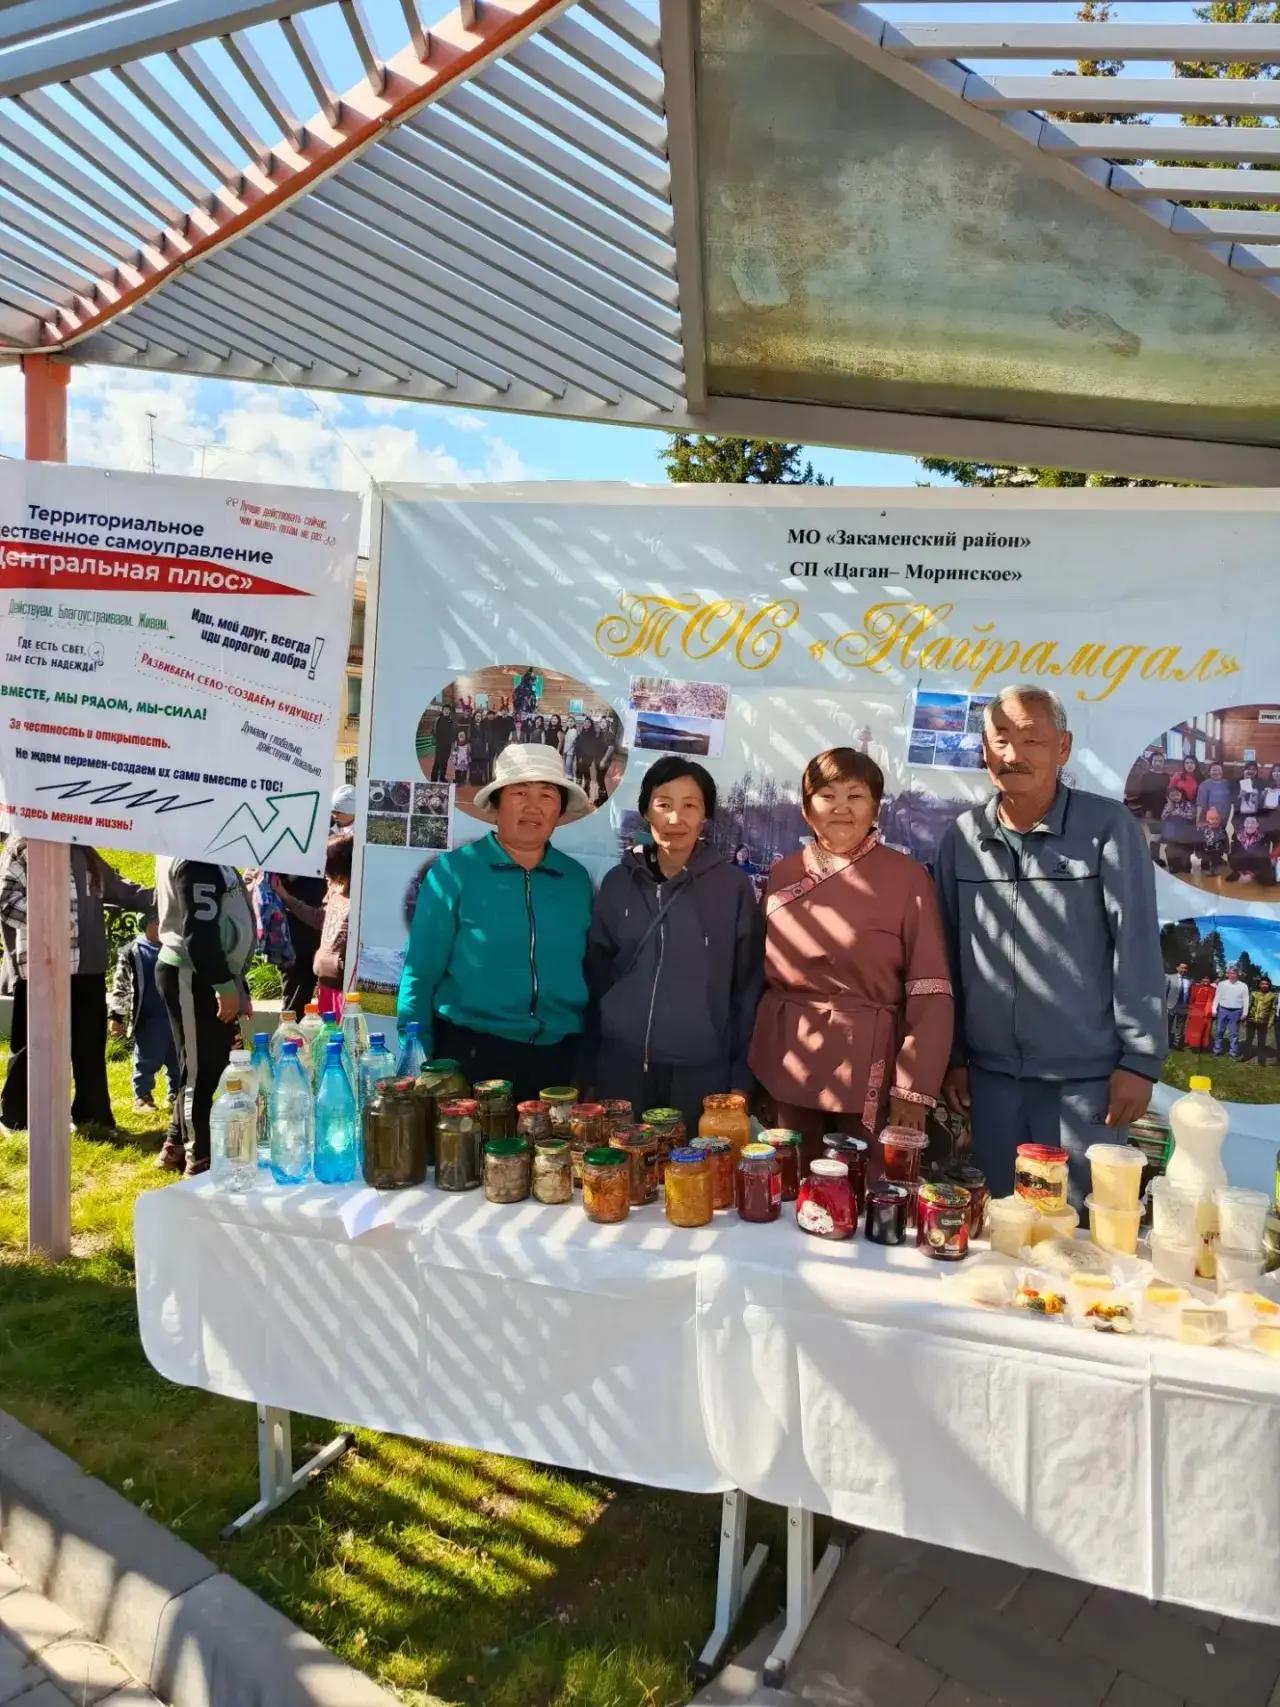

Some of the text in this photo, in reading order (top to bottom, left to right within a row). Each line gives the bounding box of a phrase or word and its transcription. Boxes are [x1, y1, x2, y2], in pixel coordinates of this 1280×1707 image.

[28, 504, 204, 537] Территориальное
[0, 525, 273, 564] ественное самоуправление
[787, 528, 1031, 551] МО «Закаменский район»
[168, 566, 253, 590] плюс»
[789, 561, 818, 577] СП
[905, 564, 1023, 583] Моринское»
[36, 640, 58, 651] ЕСТЬ
[191, 608, 311, 654] Иди, мой друг, всегда
[595, 592, 1241, 702] ТОС «Найрамдал»
[25, 656, 47, 666] ЕСТЬ
[51, 659, 97, 672] НАДЕЖДА!
[201, 629, 307, 670] иди дорогою добра
[0, 685, 207, 720] ВМЕСТЕ, МЫ РЯДОМ, МЫ-СИЛА!
[278, 702, 323, 725] БУДУЩЕЕ!
[9, 718, 171, 749] За честность и открытость.
[16, 747, 283, 792] Не ждем перемен-создаем их сами вместе с ТОС!
[20, 807, 48, 819] здесь
[51, 811, 92, 825] меняем
[96, 816, 133, 831] жизнь!
[193, 884, 217, 921] 5
